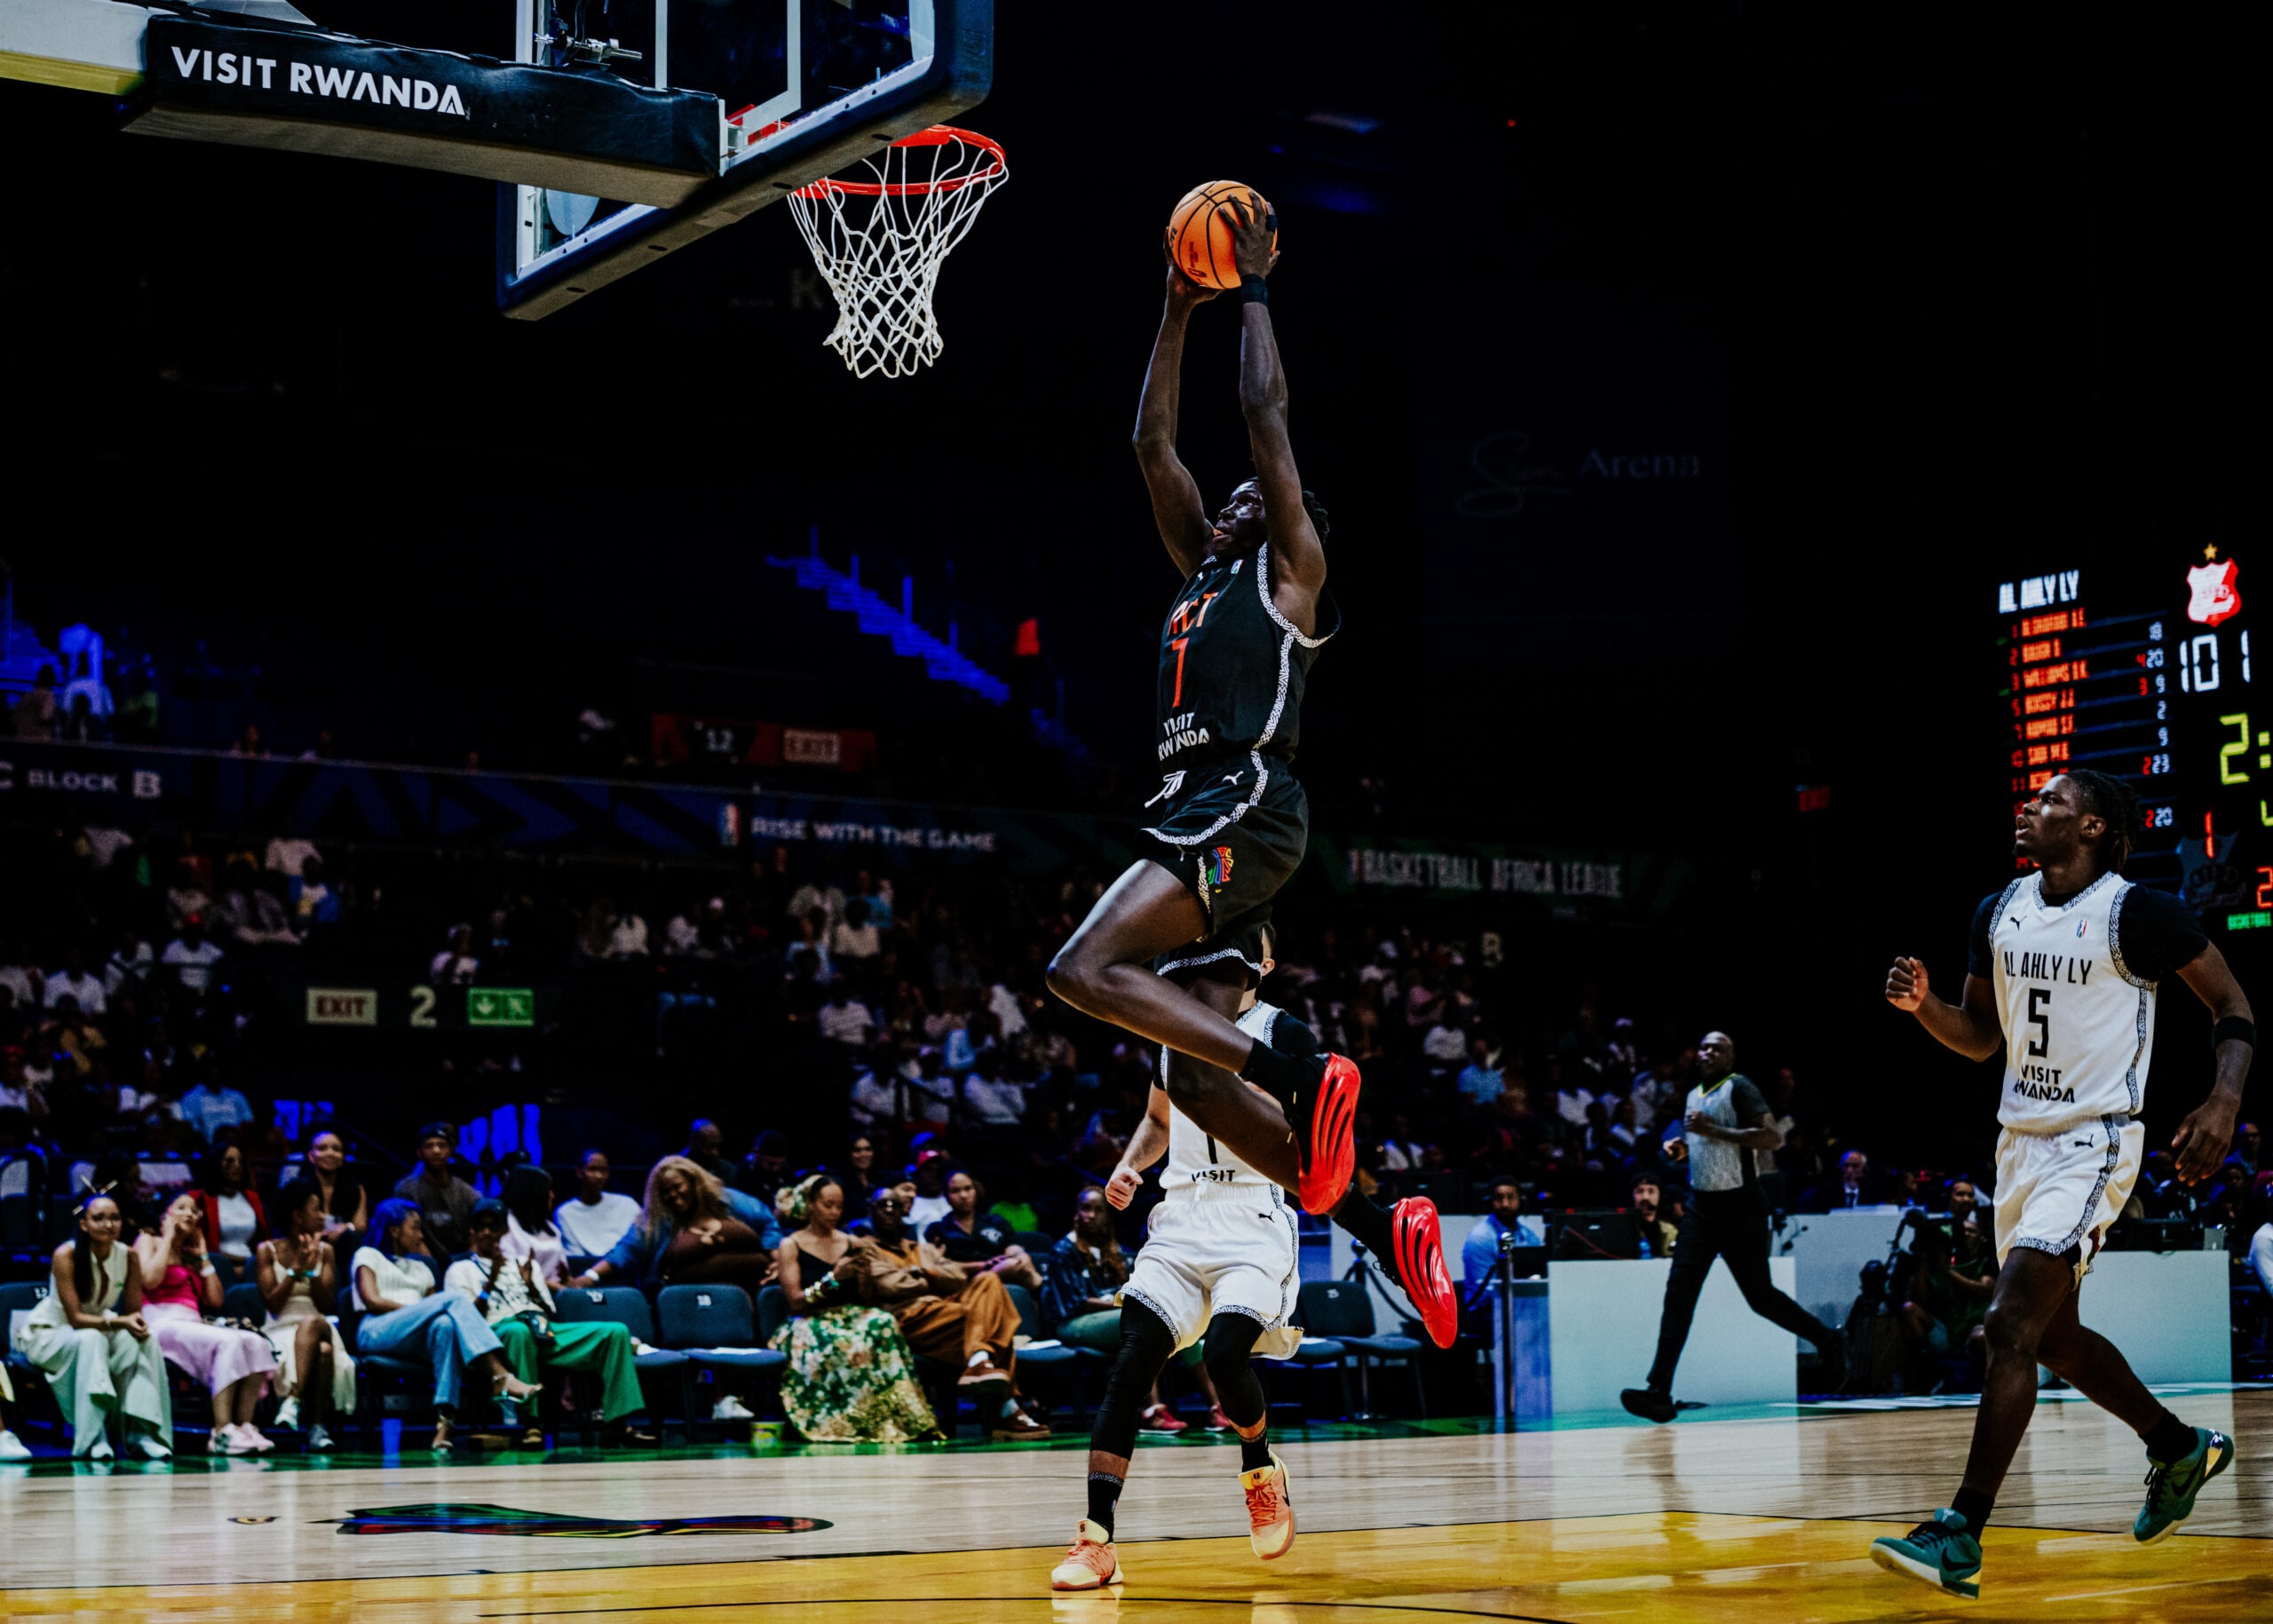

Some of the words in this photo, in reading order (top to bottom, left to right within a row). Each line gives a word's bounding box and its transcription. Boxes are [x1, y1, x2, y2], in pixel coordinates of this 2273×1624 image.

[171, 46, 277, 90] VISIT
[289, 61, 466, 116] RWANDA
[1578, 448, 1700, 479] Arena
[1172, 638, 1189, 708] 7
[2180, 630, 2251, 693] 101
[27, 768, 121, 794] BLOCK
[132, 770, 164, 800] B
[750, 816, 808, 841] RISE
[812, 820, 875, 844] WITH
[880, 825, 924, 847] THE
[927, 828, 997, 852] GAME
[1362, 848, 1483, 891] BASKETBALL
[1490, 858, 1556, 895] AFRICA
[1561, 861, 1624, 899] LEAGUE
[2004, 951, 2016, 977] AL
[2021, 952, 2063, 981] AHLY
[2067, 957, 2093, 985] LY
[316, 997, 365, 1017] EXIT
[408, 983, 439, 1028] 2
[2028, 987, 2051, 1058] 5
[2021, 1064, 2062, 1085] VISIT
